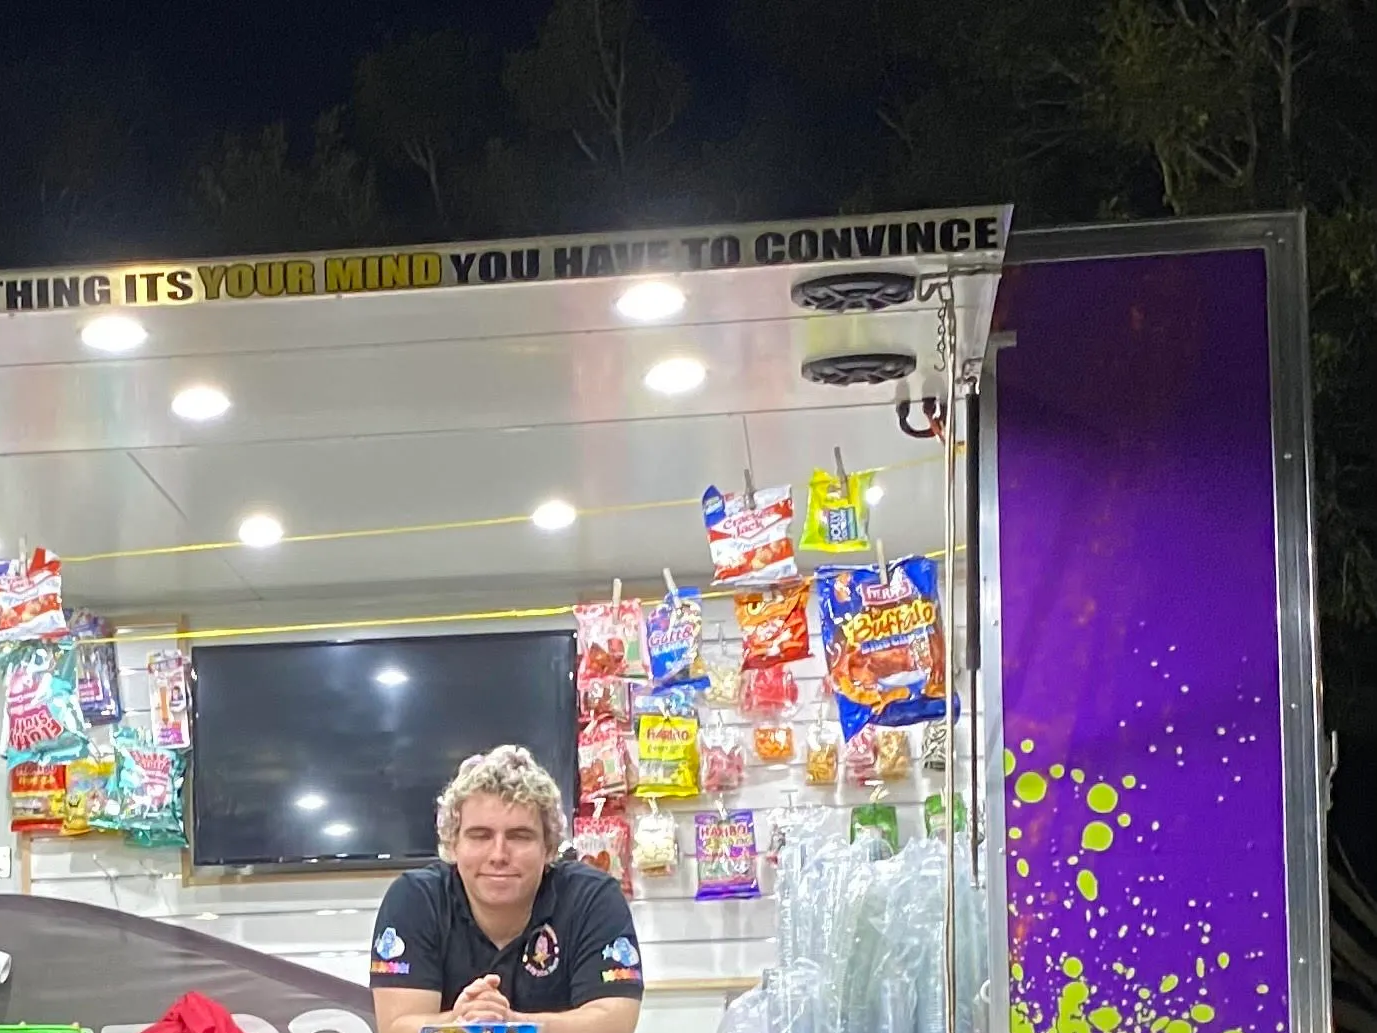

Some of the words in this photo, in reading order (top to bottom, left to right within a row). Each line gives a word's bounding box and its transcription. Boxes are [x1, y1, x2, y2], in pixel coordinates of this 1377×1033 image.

[125, 271, 192, 303] ITS
[198, 260, 316, 300] YOUR
[324, 252, 442, 293] MIND
[450, 249, 540, 283] YOU
[554, 241, 669, 278] HAVE
[680, 235, 740, 269] TO
[755, 217, 997, 264] CONVINCE
[855, 602, 934, 640] Buffalo
